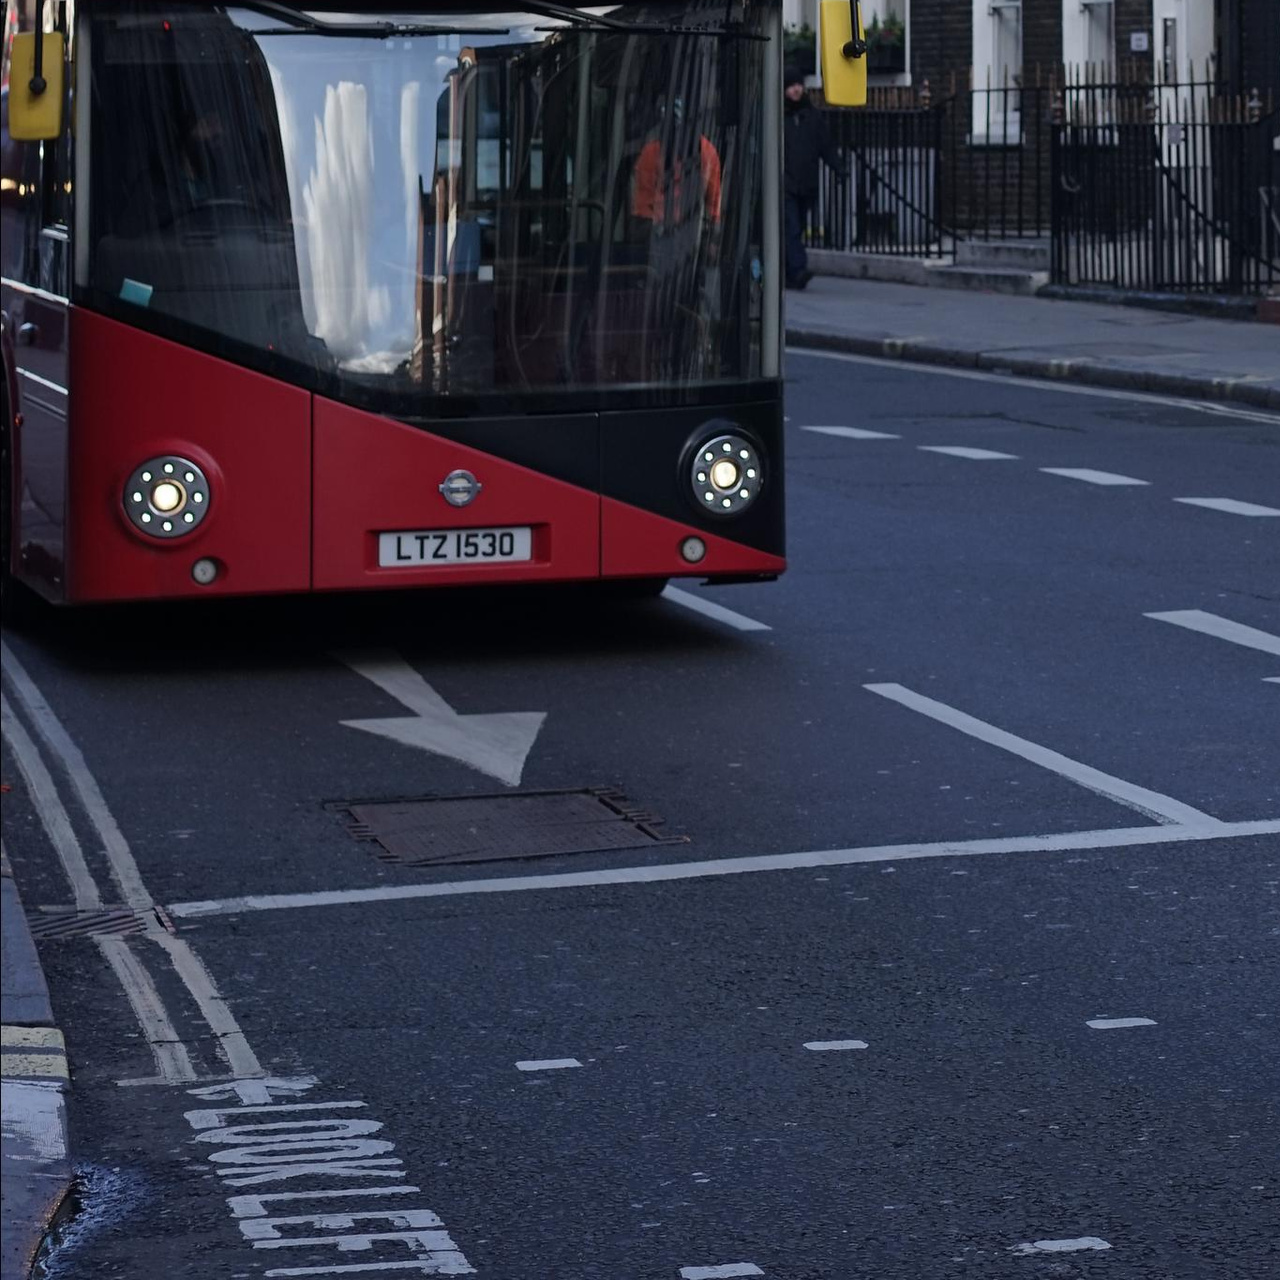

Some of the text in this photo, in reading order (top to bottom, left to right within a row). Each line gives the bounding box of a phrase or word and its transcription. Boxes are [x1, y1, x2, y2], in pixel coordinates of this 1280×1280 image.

[396, 532, 514, 560] LTZ 1530
[183, 1100, 407, 1186] LOOK
[225, 1185, 479, 1278] LEFT
